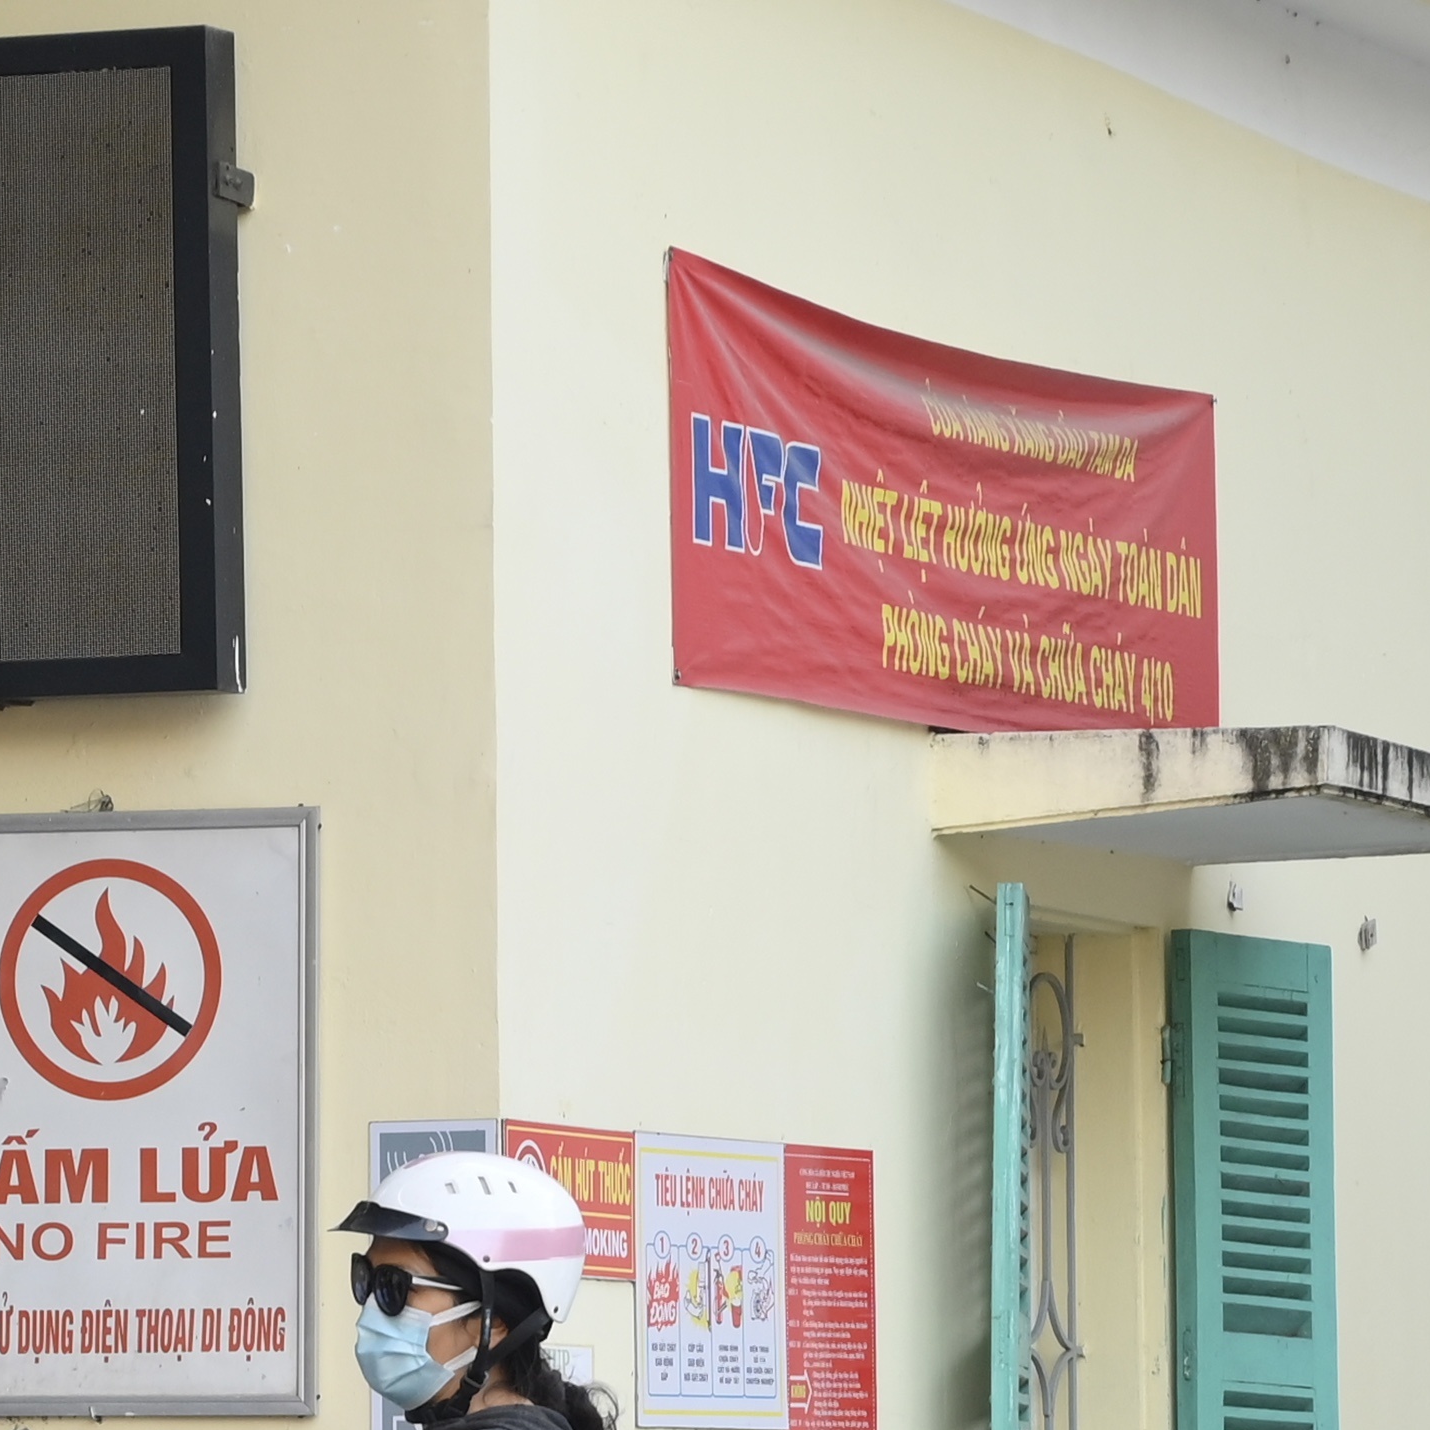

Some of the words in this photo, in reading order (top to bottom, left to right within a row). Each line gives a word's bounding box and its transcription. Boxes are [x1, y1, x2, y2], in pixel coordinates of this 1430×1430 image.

[690, 412, 824, 570] HFC
[840, 467, 899, 574] NHIỆT
[901, 479, 943, 584] LIỆT
[942, 481, 1013, 582] HƯỞNG
[1013, 503, 1059, 591] ỨNG
[1058, 517, 1113, 601] NGÀY
[1116, 527, 1163, 610] TOÀN
[1165, 536, 1202, 620] DÂN
[881, 590, 951, 680] PHÒNG
[952, 606, 1003, 691] CHÁY
[1006, 614, 1037, 697] VÀ
[1038, 622, 1089, 706] CHỮA
[1088, 632, 1138, 715] CHÁY
[1140, 655, 1174, 725] 4/10
[139, 1121, 280, 1205] LỬA
[575, 1147, 596, 1202] HÚT
[598, 1147, 631, 1206] THUỐC
[655, 1166, 677, 1207] TIÊU
[680, 1168, 706, 1216] LỆNH
[708, 1170, 735, 1211] CHỮA
[739, 1172, 764, 1213] CHÁY
[805, 1196, 826, 1228] NỘI
[829, 1201, 851, 1226] QUY
[97, 1220, 232, 1261] FIRE
[584, 1227, 628, 1258] MOKING
[659, 1237, 664, 1253] 1
[691, 1238, 698, 1254] 2
[723, 1240, 730, 1257] 3
[755, 1242, 761, 1258] 4
[653, 1280, 670, 1299] BÁO
[17, 1309, 73, 1364] DỤNG
[80, 1299, 128, 1363] ĐIỆN
[135, 1307, 195, 1362] THOẠI
[200, 1307, 222, 1353] DI
[228, 1297, 287, 1362] ĐỘNG
